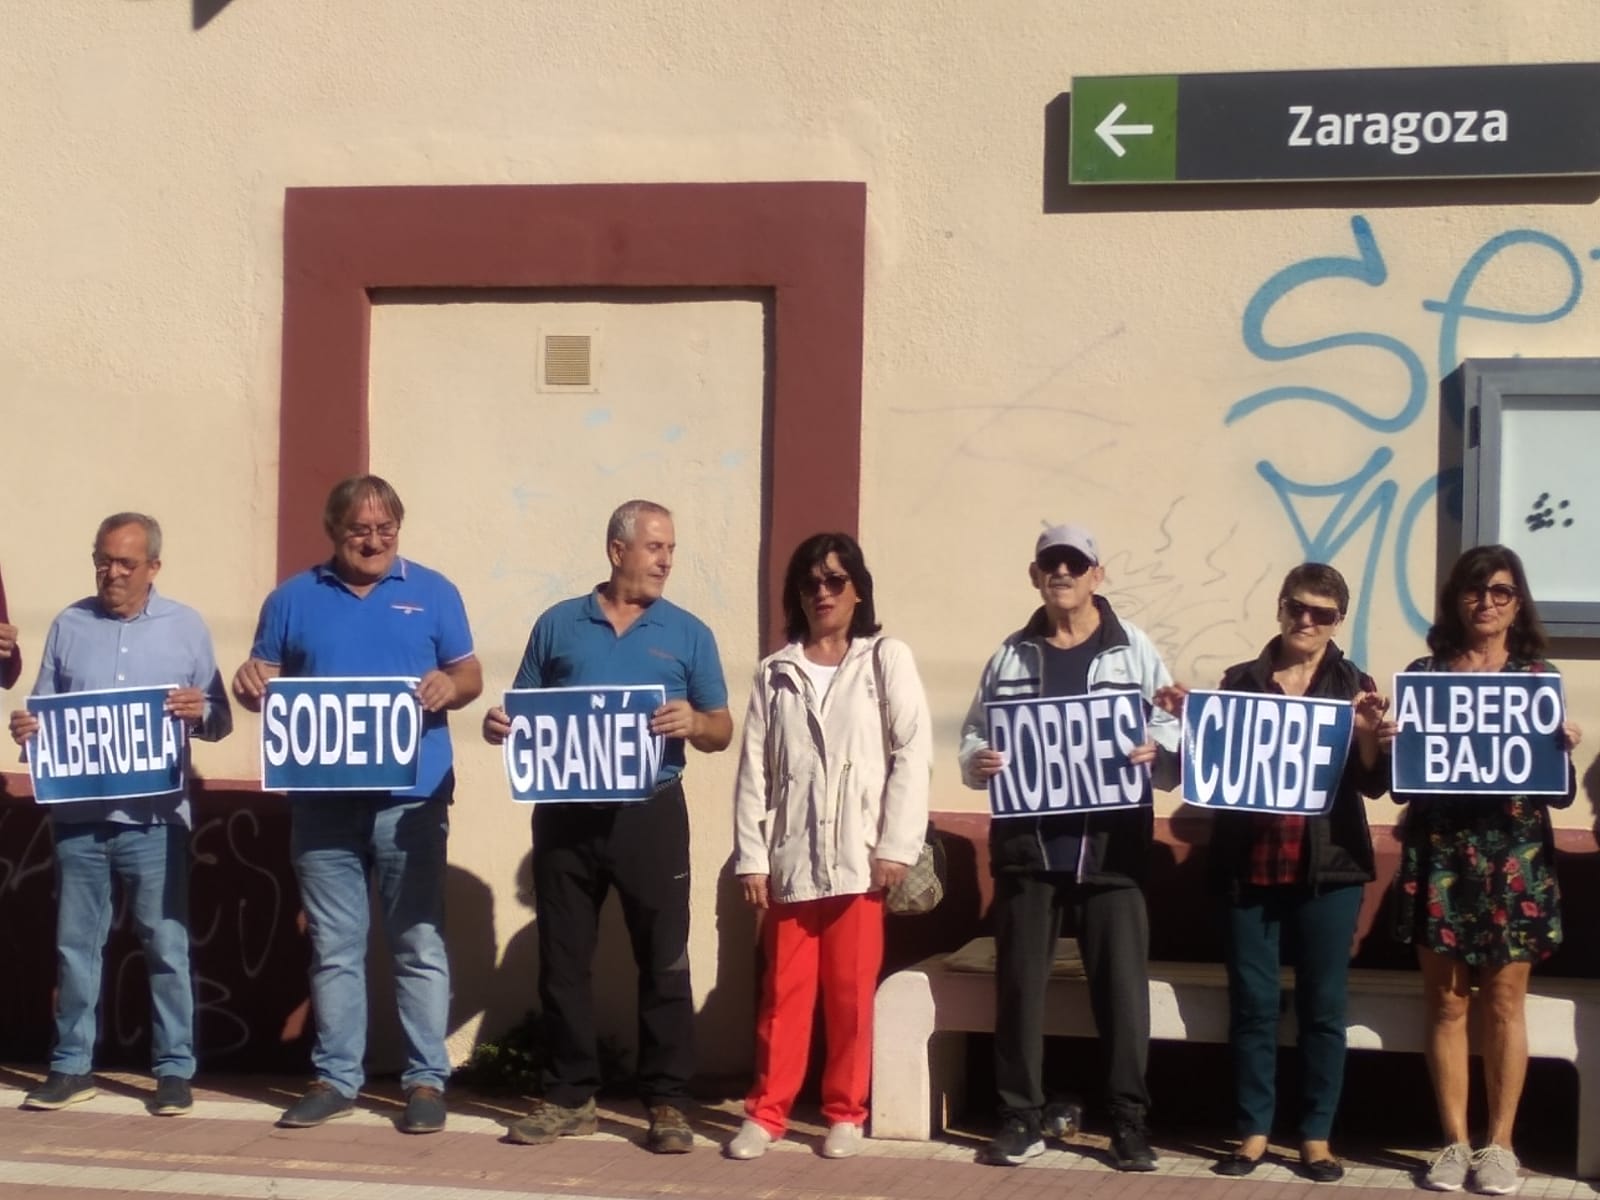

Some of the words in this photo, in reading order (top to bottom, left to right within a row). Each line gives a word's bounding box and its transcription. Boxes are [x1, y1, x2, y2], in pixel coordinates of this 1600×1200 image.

[1288, 106, 1508, 154] Zaragoza
[36, 702, 178, 779] ALBERUELA
[266, 693, 417, 766] SODETO
[507, 692, 661, 793] GRAÑÉN
[1398, 686, 1561, 735] ALBERO
[990, 696, 1142, 811] ROBRES
[1194, 696, 1336, 809] CURBE
[1425, 735, 1532, 784] BAJO
